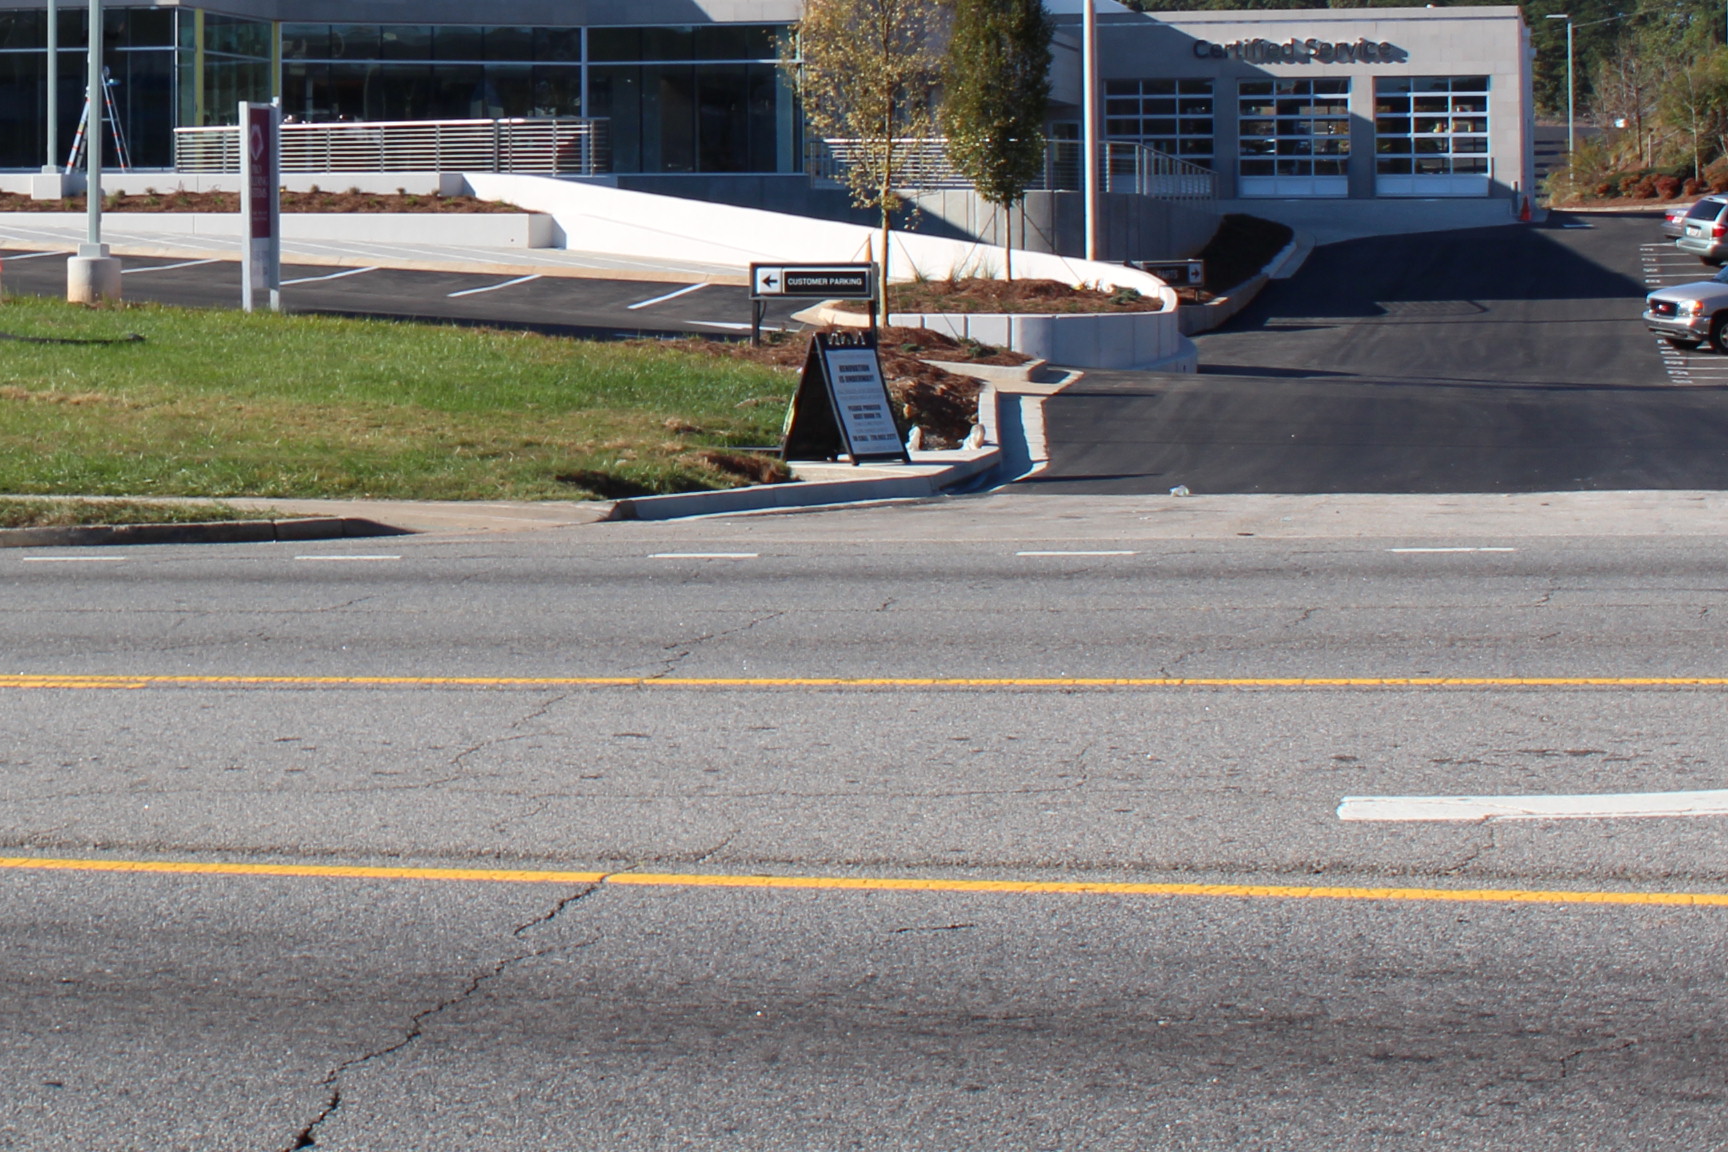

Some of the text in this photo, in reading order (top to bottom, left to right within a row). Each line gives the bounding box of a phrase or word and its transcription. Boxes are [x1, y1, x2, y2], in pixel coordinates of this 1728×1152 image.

[1193, 37, 1393, 59] Certified Service
[787, 277, 862, 286] CUSTOMER PARKING
